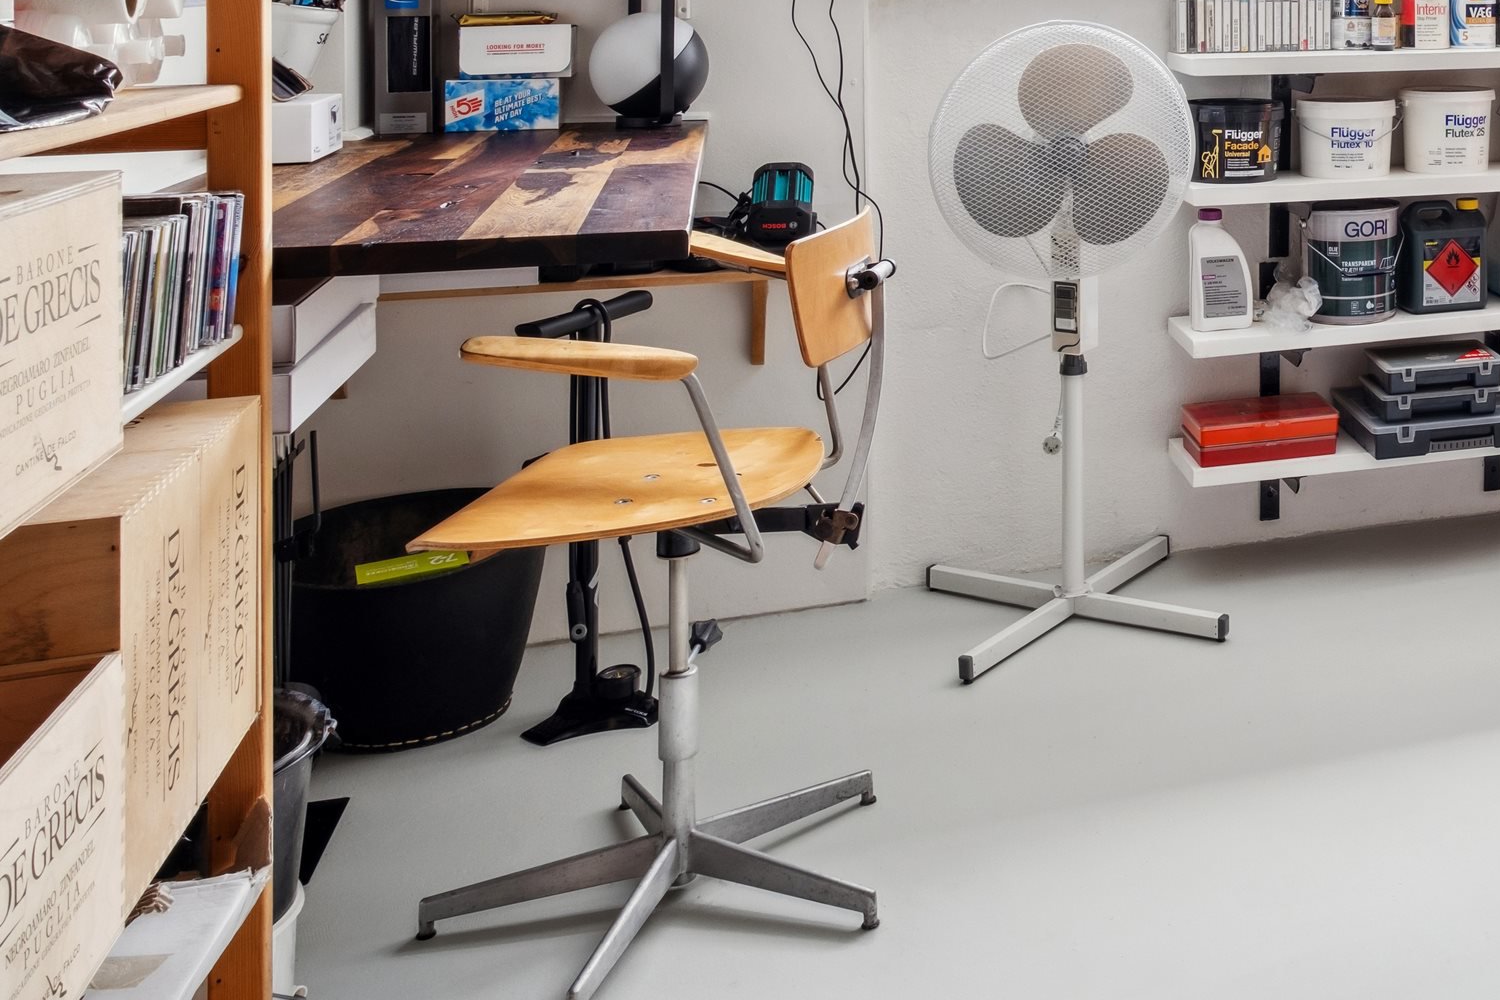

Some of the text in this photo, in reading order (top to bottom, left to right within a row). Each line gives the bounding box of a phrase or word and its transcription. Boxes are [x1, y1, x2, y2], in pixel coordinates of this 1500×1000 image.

[1416, 3, 1446, 16] Interior
[1468, 6, 1492, 18] VÆG
[1461, 31, 1469, 41] 5
[494, 89, 531, 108] BE AT YOUR
[494, 99, 525, 115] ULTIMATE
[494, 108, 523, 124] ANY DAY
[1445, 114, 1487, 128] Flügger
[1224, 129, 1264, 141] Flügger
[1330, 127, 1375, 140] Flügger
[1445, 128, 1475, 138] Flutex
[1224, 141, 1259, 150] Facade
[1224, 150, 1251, 158] Universal
[1330, 140, 1374, 149] Flutex 10
[1344, 219, 1387, 238] GORI
[16, 245, 74, 285] BARONE
[1341, 259, 1376, 267] TRANSPARENT
[0, 259, 101, 346] E GRECIS
[53, 336, 91, 369] ZINFANDEL
[16, 365, 75, 415] PUGLIA
[0, 412, 33, 439] NDICAZIONE
[15, 450, 44, 476] CANTINE
[57, 430, 77, 447] FALCO
[234, 464, 245, 695] DE GRECIS
[167, 528, 181, 791] DE GRECIS
[24, 759, 81, 841] BARONE
[31, 754, 105, 881] GRECIS
[4, 839, 95, 971] NEGROAMARO ZINFANDEL
[22, 880, 81, 970] PUGLIA
[62, 943, 81, 974] FALCO
